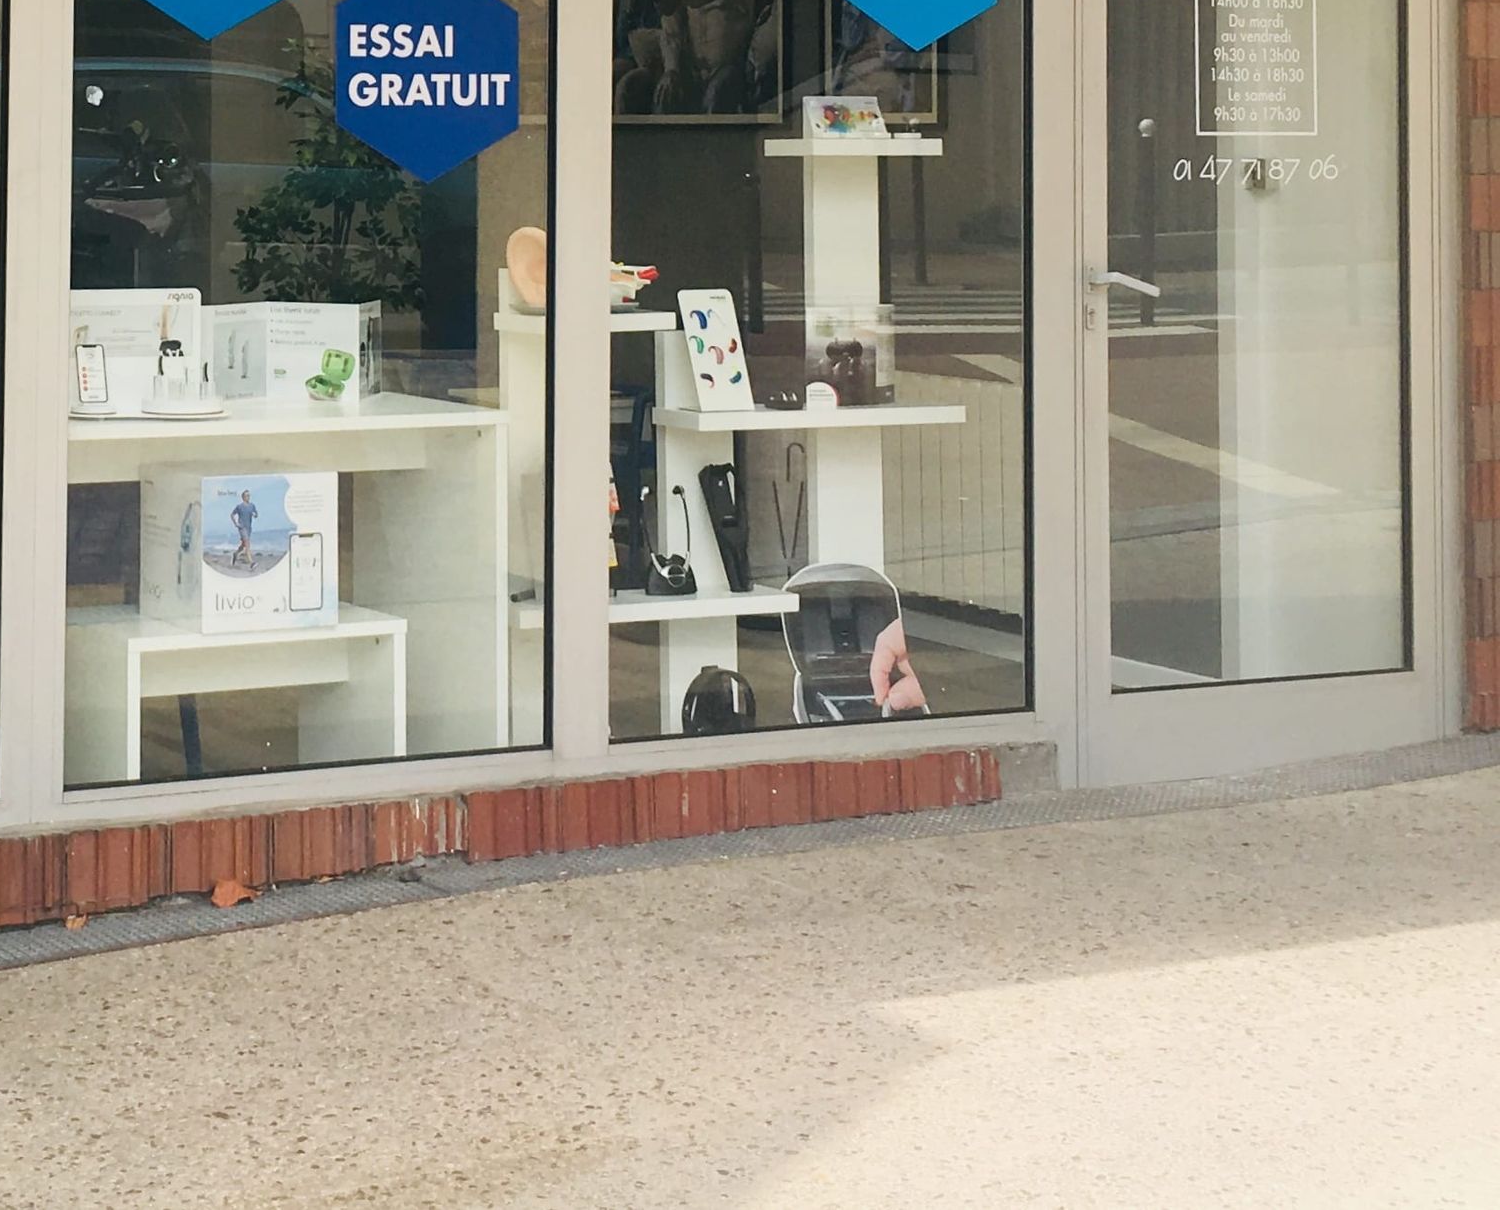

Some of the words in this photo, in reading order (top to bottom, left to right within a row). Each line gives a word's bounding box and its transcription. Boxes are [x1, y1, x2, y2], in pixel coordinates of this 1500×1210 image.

[1229, 14, 1246, 28] Du
[1250, 14, 1284, 30] mardi
[348, 23, 455, 59] ESSAI
[1221, 31, 1237, 43] au
[1239, 29, 1291, 44] vendredi
[1213, 48, 1246, 63] 9h30
[1262, 48, 1300, 63] 13h00
[1210, 67, 1249, 82] 14h30
[1266, 68, 1305, 83] 18h30
[348, 72, 511, 108] GRATUIT
[1228, 87, 1241, 102] Le
[1244, 87, 1287, 102] samedi
[1213, 107, 1246, 122] 9h30
[1262, 107, 1301, 122] 17h30
[1173, 158, 1192, 181] 01
[1199, 154, 1232, 185] 47
[1240, 158, 1262, 185] 71
[1268, 158, 1300, 185] 87
[1308, 154, 1339, 181] 06
